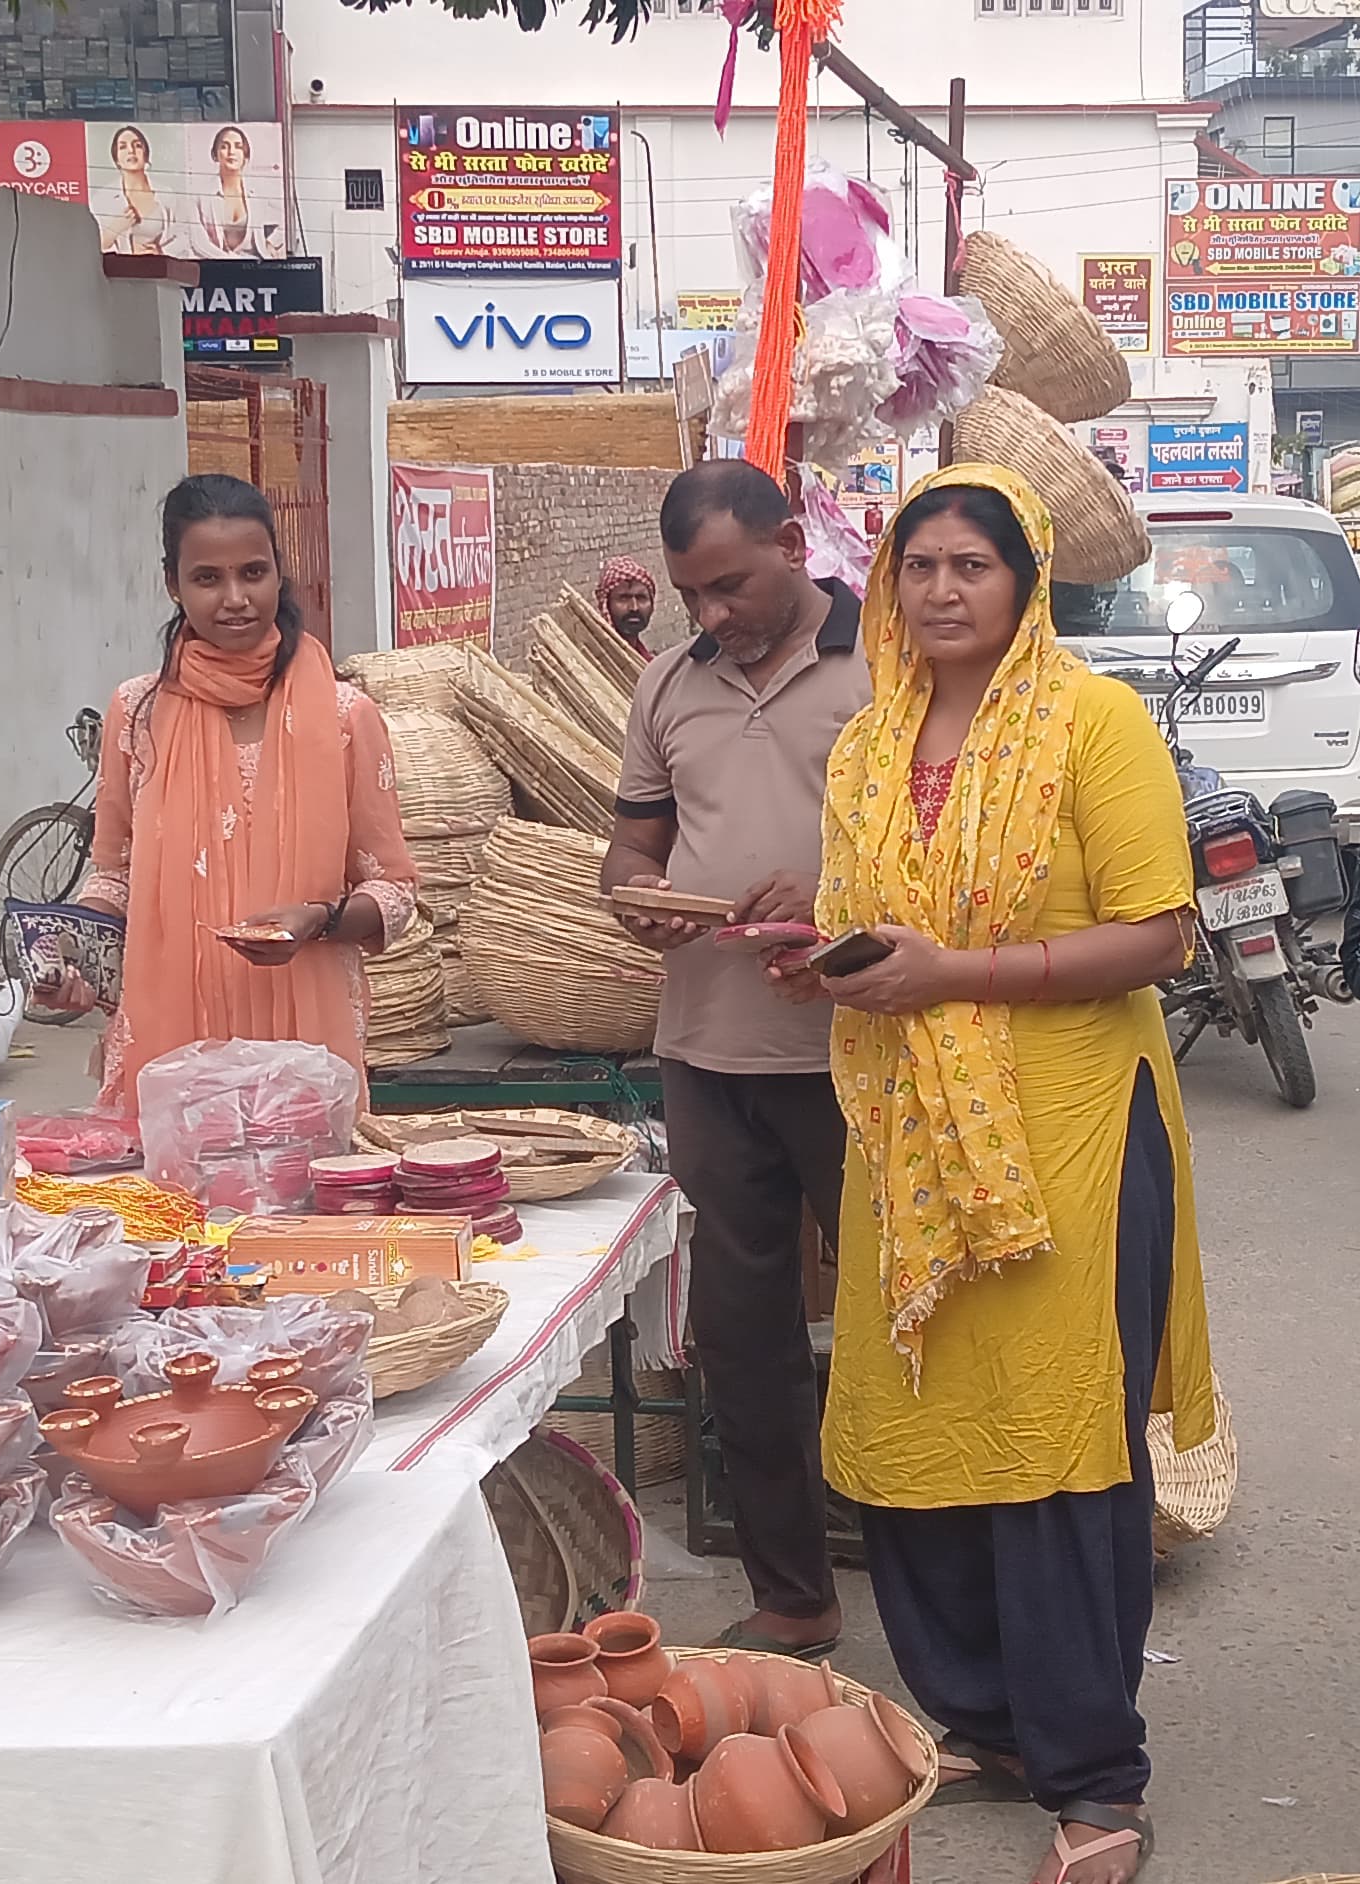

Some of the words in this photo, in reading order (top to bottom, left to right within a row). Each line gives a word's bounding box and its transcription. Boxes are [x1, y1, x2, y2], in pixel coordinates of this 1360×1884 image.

[456, 116, 572, 150] Online
[409, 152, 426, 170] से
[434, 152, 457, 171] भी
[463, 155, 509, 172] सस्ता
[514, 153, 552, 173] फोन
[1204, 183, 1325, 210] ONLINE
[1183, 216, 1196, 231] से
[1203, 215, 1222, 231] भी
[1227, 218, 1264, 231] सस्ता
[1269, 215, 1301, 231] फोन
[414, 226, 457, 245] SBD
[463, 226, 538, 245] MOBILE
[544, 226, 608, 245] STORE
[1207, 248, 1231, 260] SBD
[1234, 247, 1280, 260] MOBILE
[1283, 247, 1322, 259] STORE
[1097, 262, 1137, 275] भरत
[1170, 294, 1210, 311] SBD
[1217, 292, 1290, 310] MOBILE
[1296, 292, 1357, 310] STORE
[434, 302, 592, 349] vivo
[1172, 313, 1226, 329] Online
[550, 369, 583, 377] MOBILE
[585, 369, 614, 377] STORE
[1151, 442, 1205, 464] पहलवान
[1208, 434, 1243, 460] लस्सी
[368, 1248, 380, 1285] Sandal
